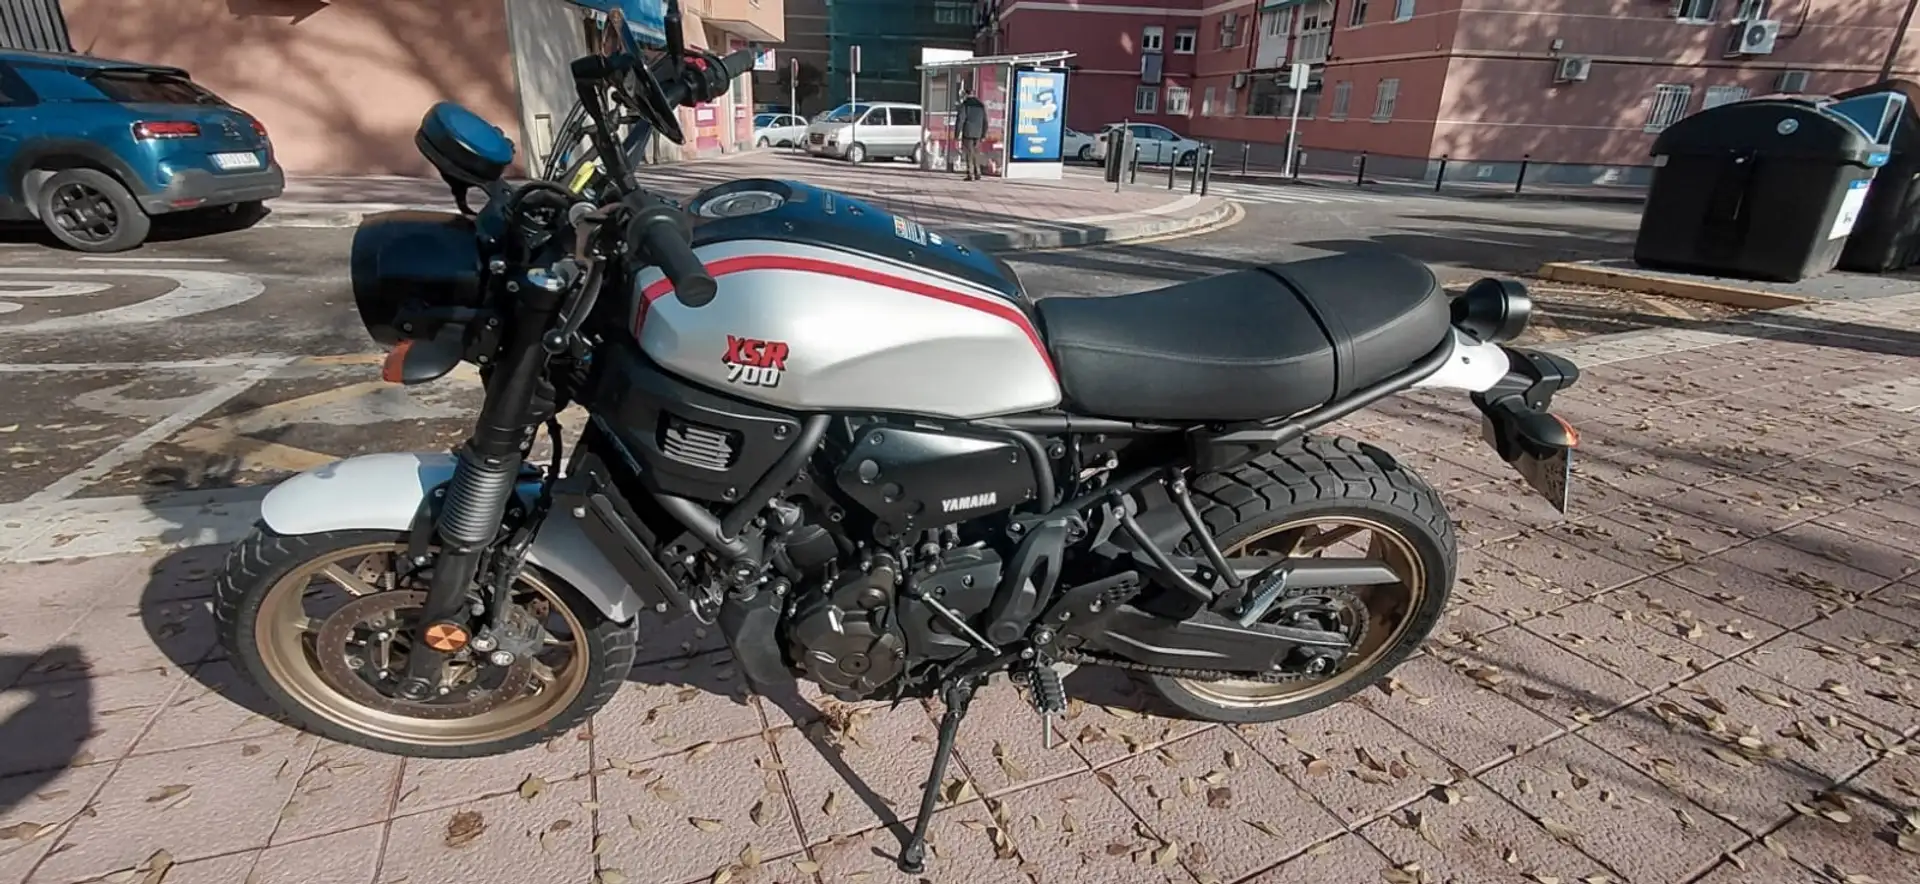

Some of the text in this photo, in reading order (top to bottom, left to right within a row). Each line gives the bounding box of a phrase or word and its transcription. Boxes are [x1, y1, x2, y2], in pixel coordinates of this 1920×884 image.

[722, 335, 789, 371] XSR
[727, 362, 780, 388] 700
[942, 491, 997, 512] YAMAHA
